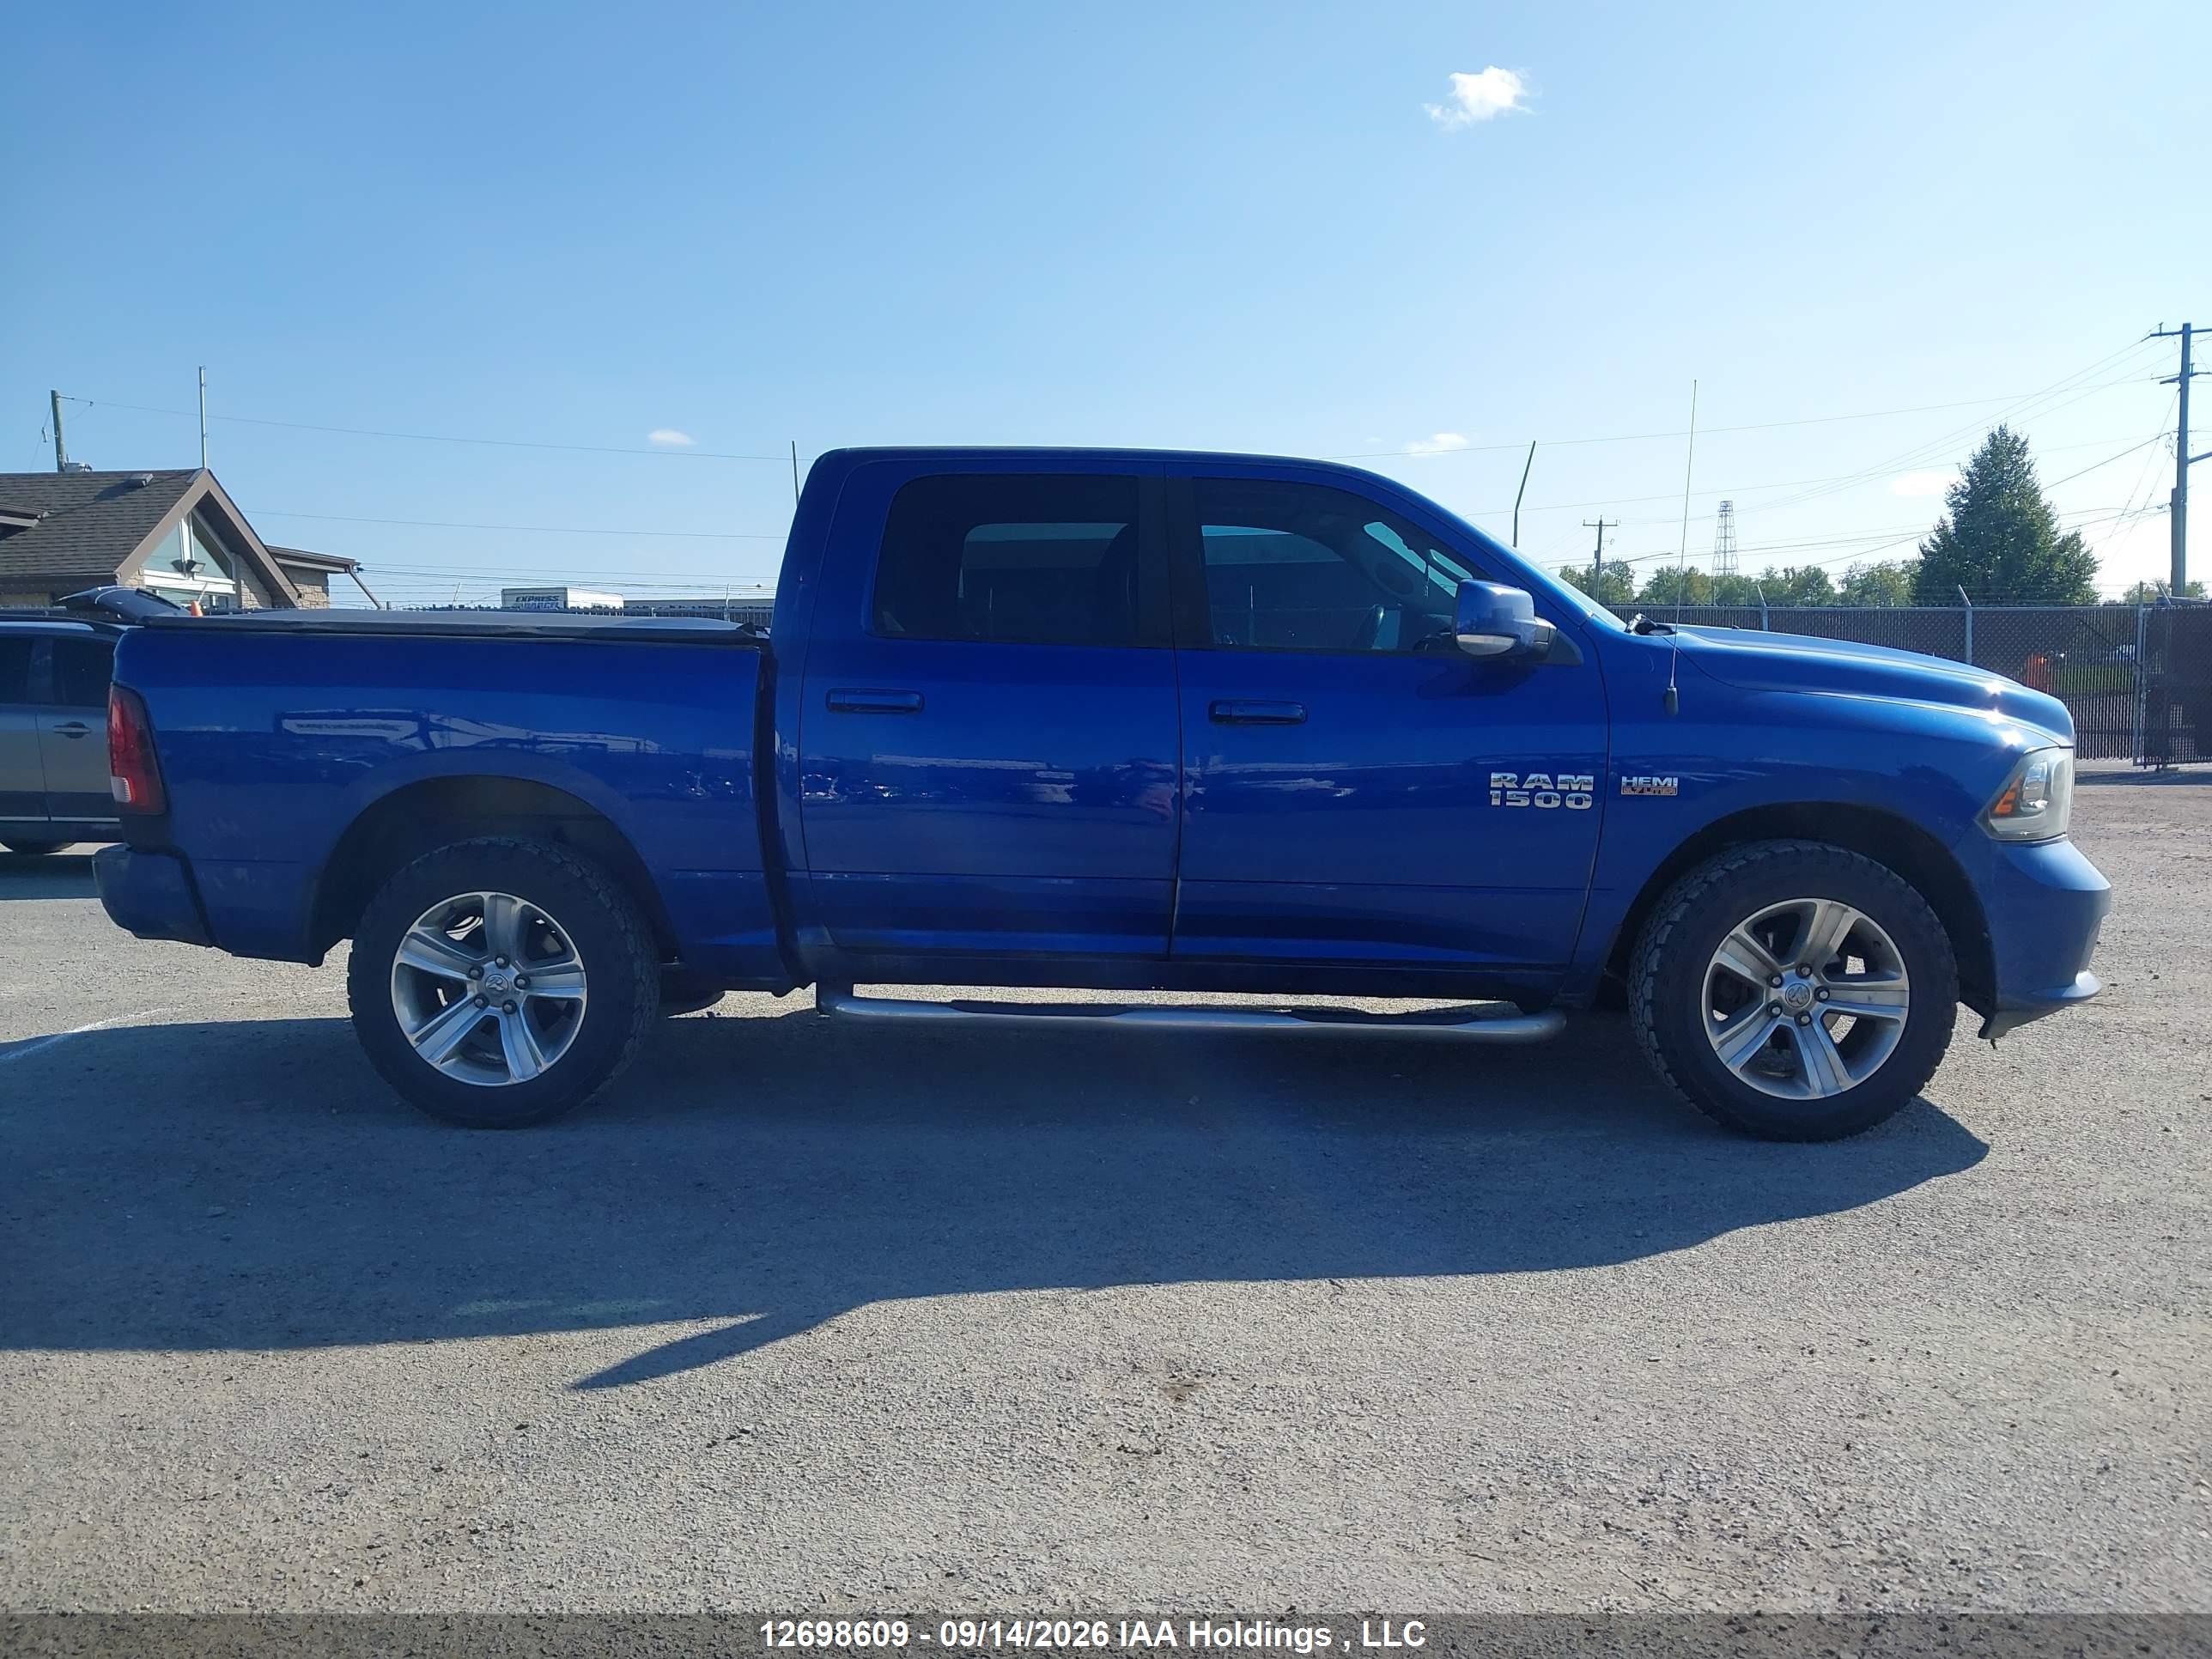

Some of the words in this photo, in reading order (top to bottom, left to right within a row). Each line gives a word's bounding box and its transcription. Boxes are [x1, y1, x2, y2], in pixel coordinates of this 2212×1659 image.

[1490, 772, 1594, 791] RAM
[1621, 775, 1679, 787] HEMI
[1489, 790, 1593, 810] 1500
